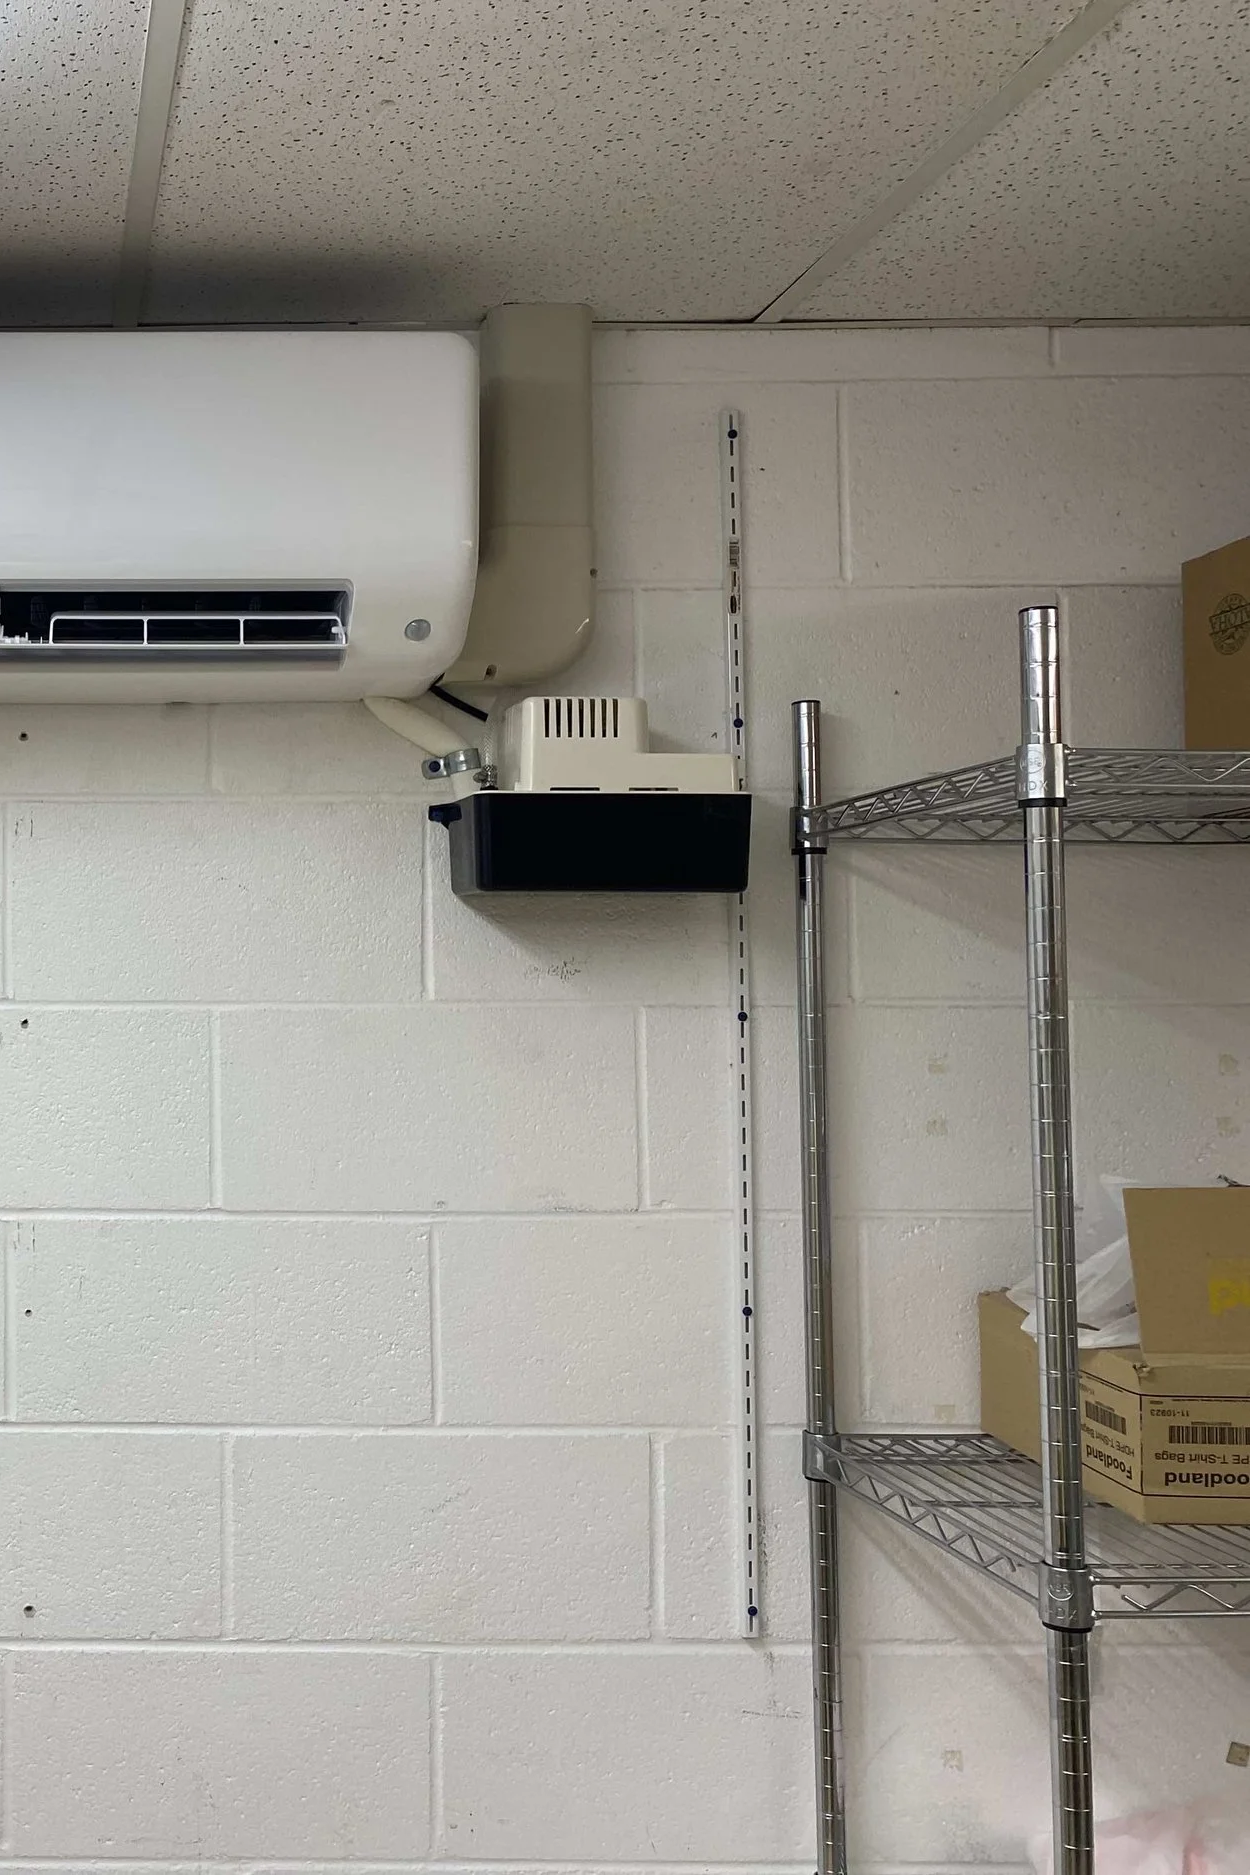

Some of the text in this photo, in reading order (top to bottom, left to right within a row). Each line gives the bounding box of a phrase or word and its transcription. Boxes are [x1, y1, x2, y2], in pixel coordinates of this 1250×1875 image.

[1085, 1444, 1133, 1480] Foodland
[1154, 1450, 1185, 1464] Bags
[1189, 1453, 1229, 1465] T-Shirt
[1164, 1472, 1250, 1488] oodland
